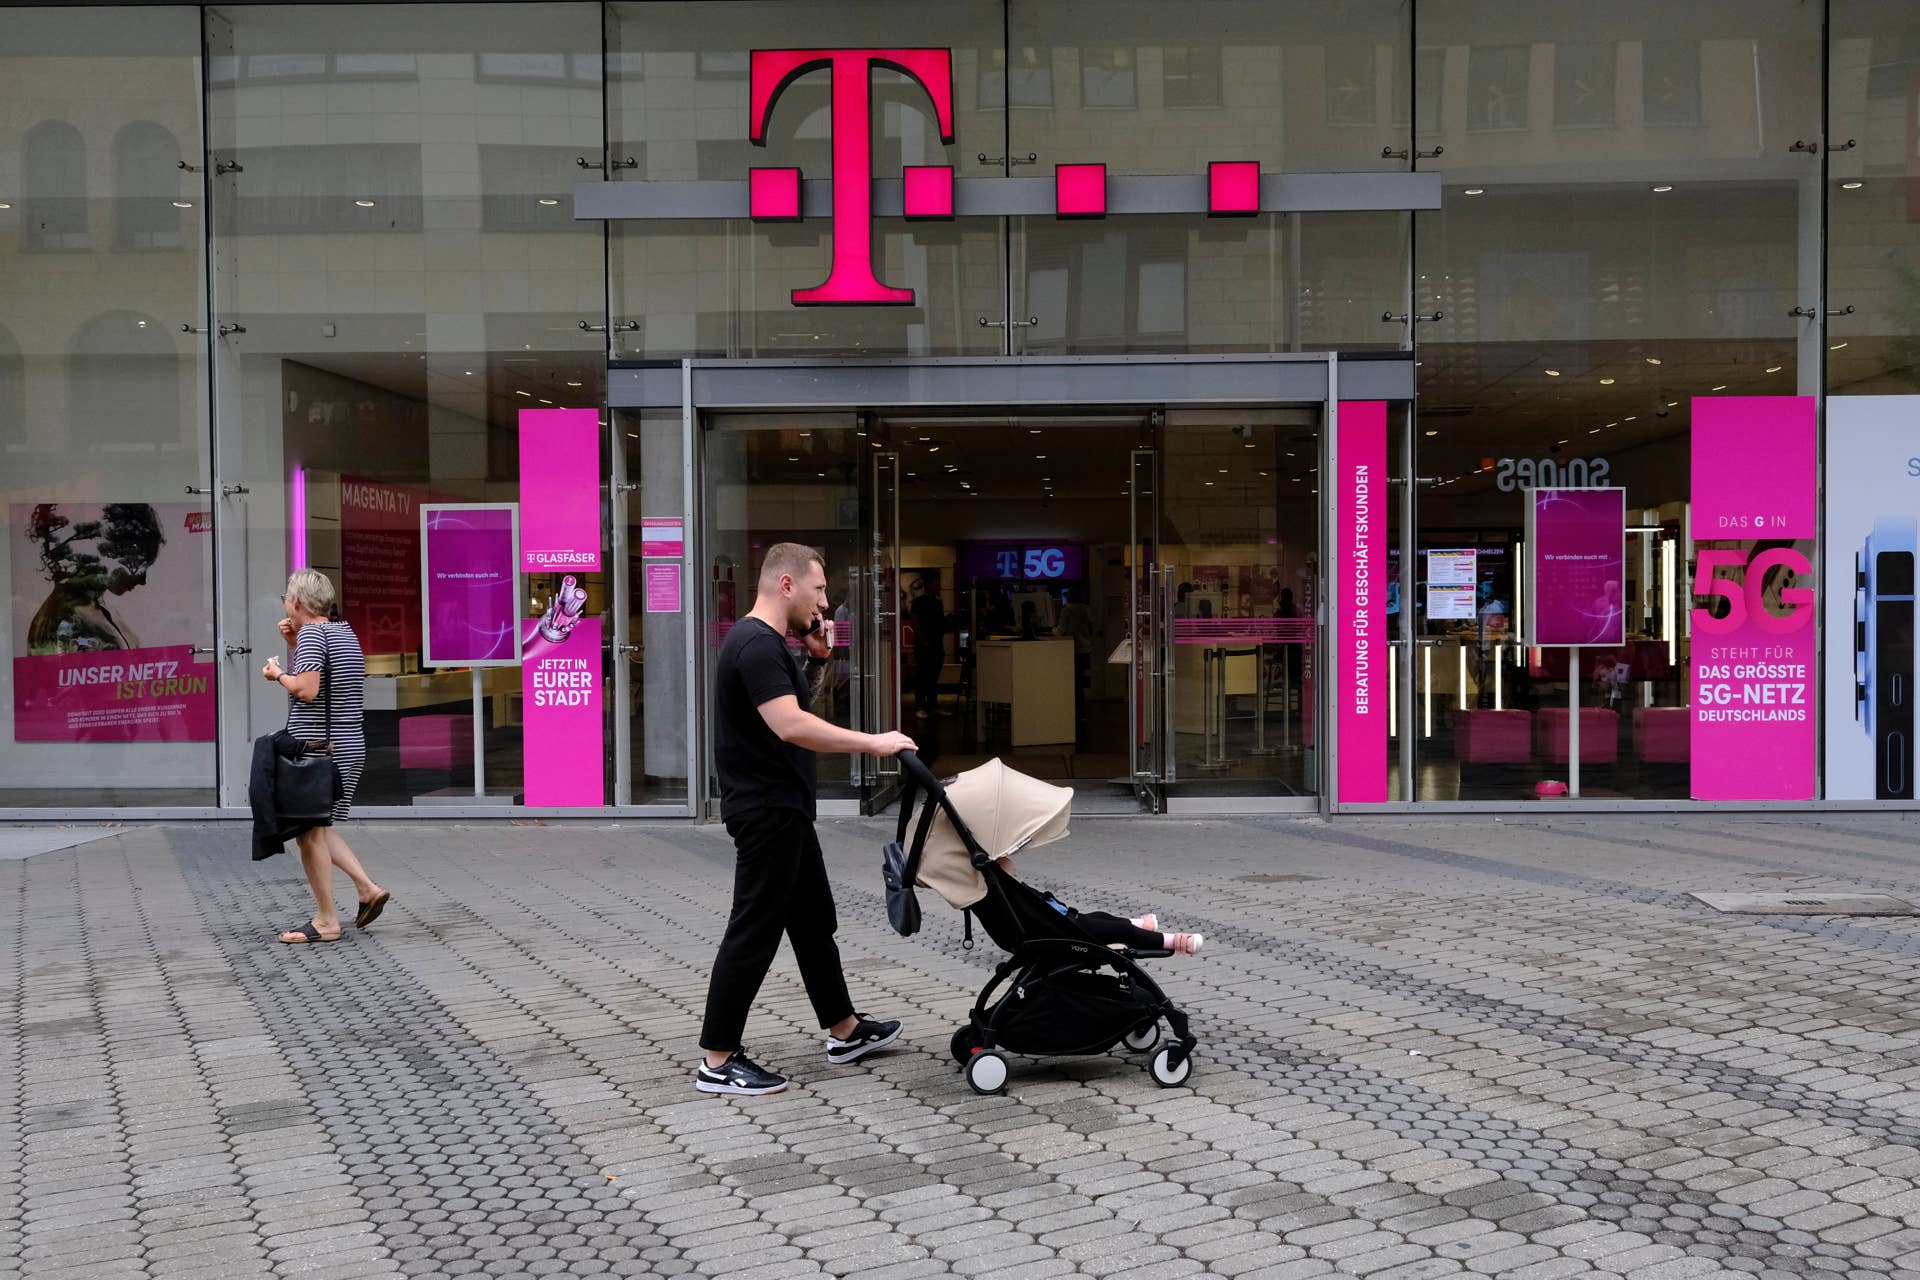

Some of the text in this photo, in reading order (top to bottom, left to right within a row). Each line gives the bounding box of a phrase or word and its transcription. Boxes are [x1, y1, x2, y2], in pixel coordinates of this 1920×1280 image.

[342, 482, 411, 515] MAGENTA TV
[1719, 516, 1786, 527] DAS G IN
[537, 553, 595, 563] GLASFASER
[1024, 548, 1065, 577] 5G
[1353, 465, 1369, 714] BERATUNG FÜR GESCHÄFTSKUNDEN
[1690, 547, 1815, 634] 5G
[1711, 645, 1793, 659] STEHT FÜR
[538, 659, 587, 670] JETZT IN
[1699, 661, 1805, 678] DAS GRÖSSTE
[59, 661, 178, 686] UNSER NETZ
[533, 672, 592, 688] EURER
[116, 674, 207, 699] IST GRÜN
[1699, 683, 1805, 705] 5G-NETZ
[534, 690, 592, 706] STADT
[1699, 709, 1806, 722] DEUTSCHLANDS
